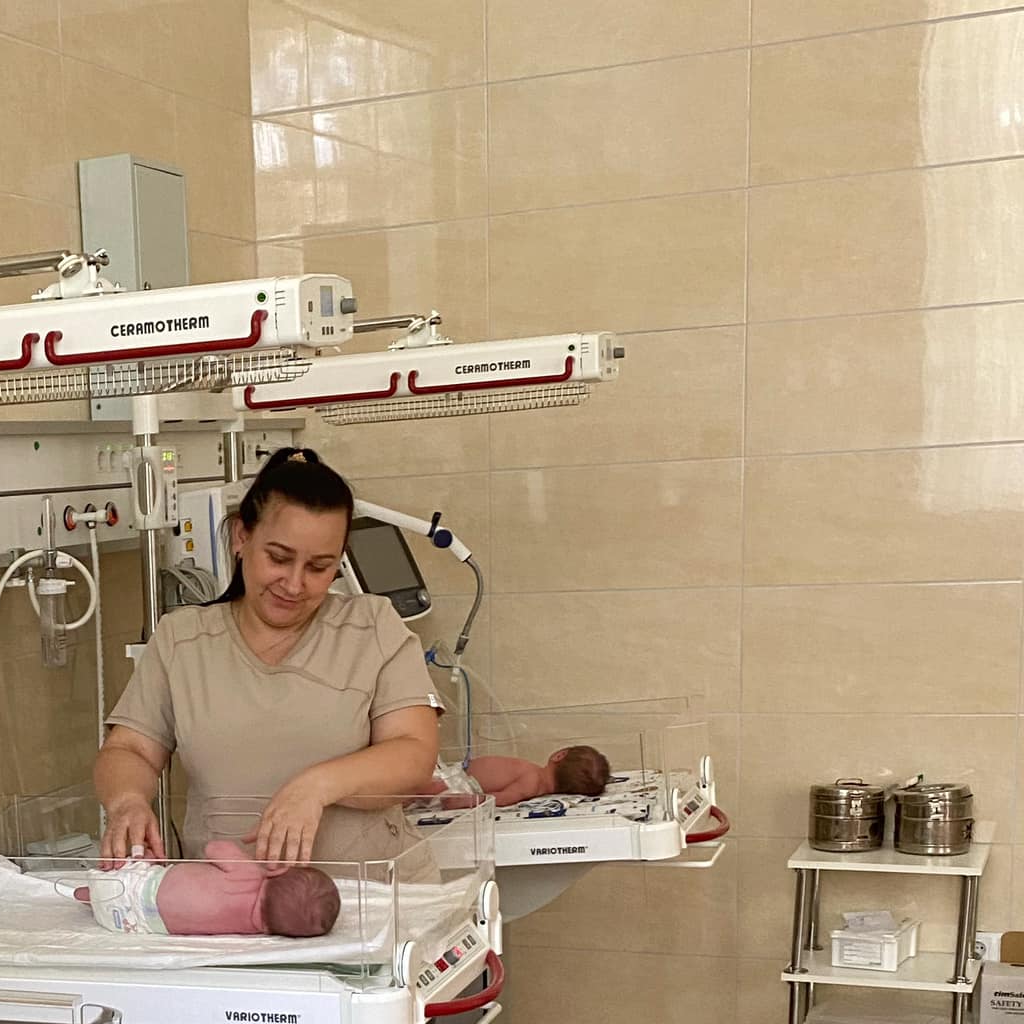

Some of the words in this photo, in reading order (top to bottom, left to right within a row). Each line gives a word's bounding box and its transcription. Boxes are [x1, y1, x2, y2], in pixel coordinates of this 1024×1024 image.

[110, 315, 209, 337] CERAMOTHERM
[455, 359, 531, 375] CERAMOTHERM
[530, 846, 586, 856] VARIOTHERM
[225, 1010, 298, 1024] VARIOTHERM
